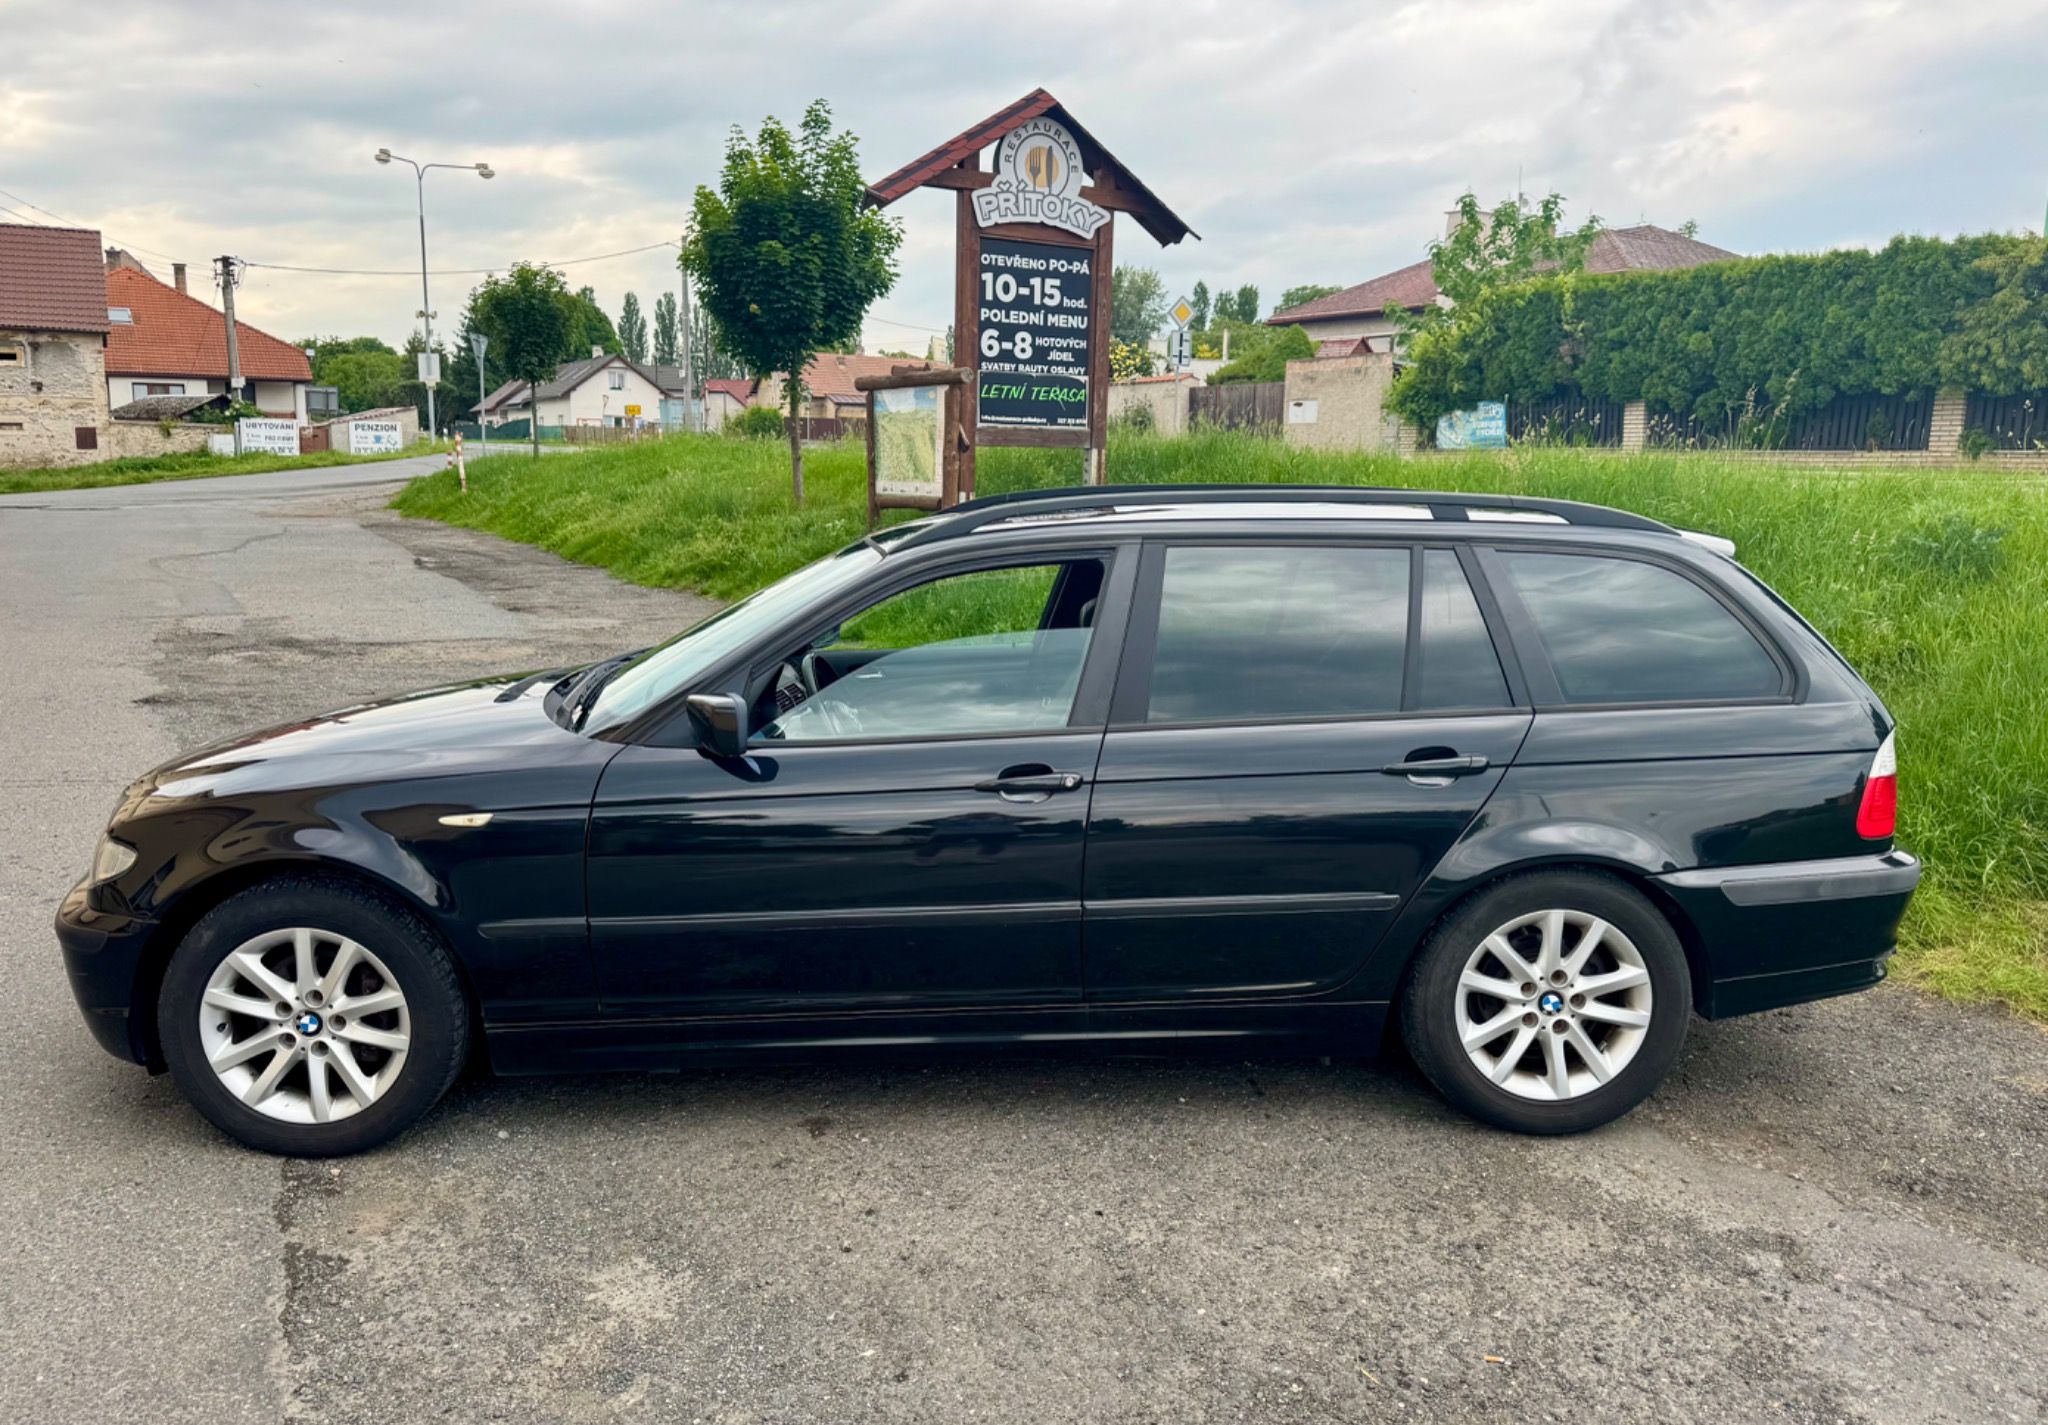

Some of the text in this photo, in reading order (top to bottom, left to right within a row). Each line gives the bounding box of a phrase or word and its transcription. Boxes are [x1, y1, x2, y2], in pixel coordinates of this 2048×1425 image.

[1004, 122, 1079, 173] RESTAURACE
[977, 180, 1105, 234] PŘÍTOKY
[980, 253, 1090, 275] OTEVŘENO PO-PÁ
[981, 272, 1088, 309] 10-15 hod.
[980, 308, 1088, 329] POLEDNÍ MENU
[980, 328, 1087, 359] 6-8 HOTOVÝCH
[1047, 349, 1075, 362] JÍDEL
[980, 361, 1086, 375] SVATBY RAUTY OSLAVY
[980, 382, 1087, 402] LETNÍ TERASA
[354, 423, 397, 432] PENZION
